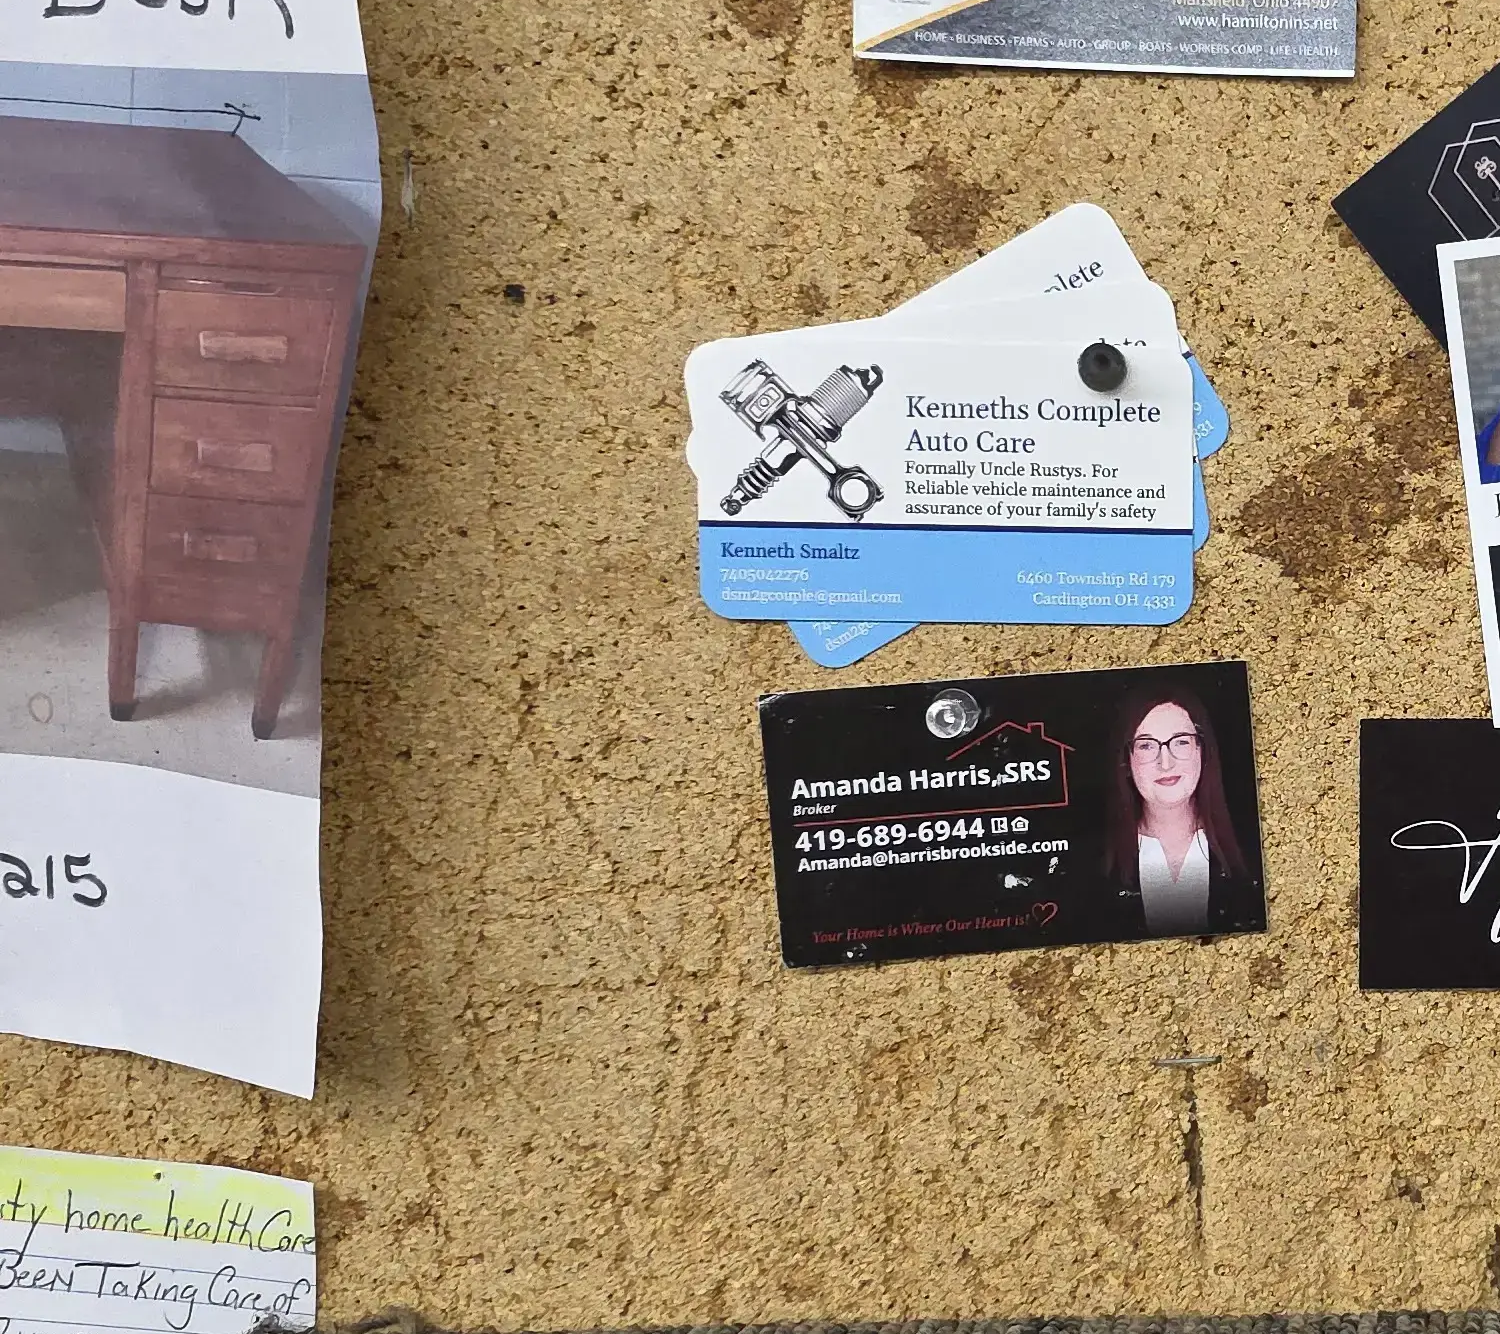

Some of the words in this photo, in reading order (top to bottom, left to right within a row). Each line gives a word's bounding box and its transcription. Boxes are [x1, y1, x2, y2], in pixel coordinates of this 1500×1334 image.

[1178, 14, 1338, 31] www.hamiltonins.net
[906, 395, 1029, 422] Kenneths
[1037, 399, 1161, 426] Complete
[906, 430, 968, 454] Auto
[976, 430, 1036, 454] Care
[721, 542, 795, 560] Kenneth
[801, 543, 860, 561] Smaltz
[791, 772, 902, 800] Amanda
[793, 802, 837, 818] Broker
[795, 817, 985, 852] 419-689-6944
[798, 837, 1069, 872] Amanda@harrisbrookside.com
[66, 1189, 152, 1234] home
[164, 1189, 253, 1251] health
